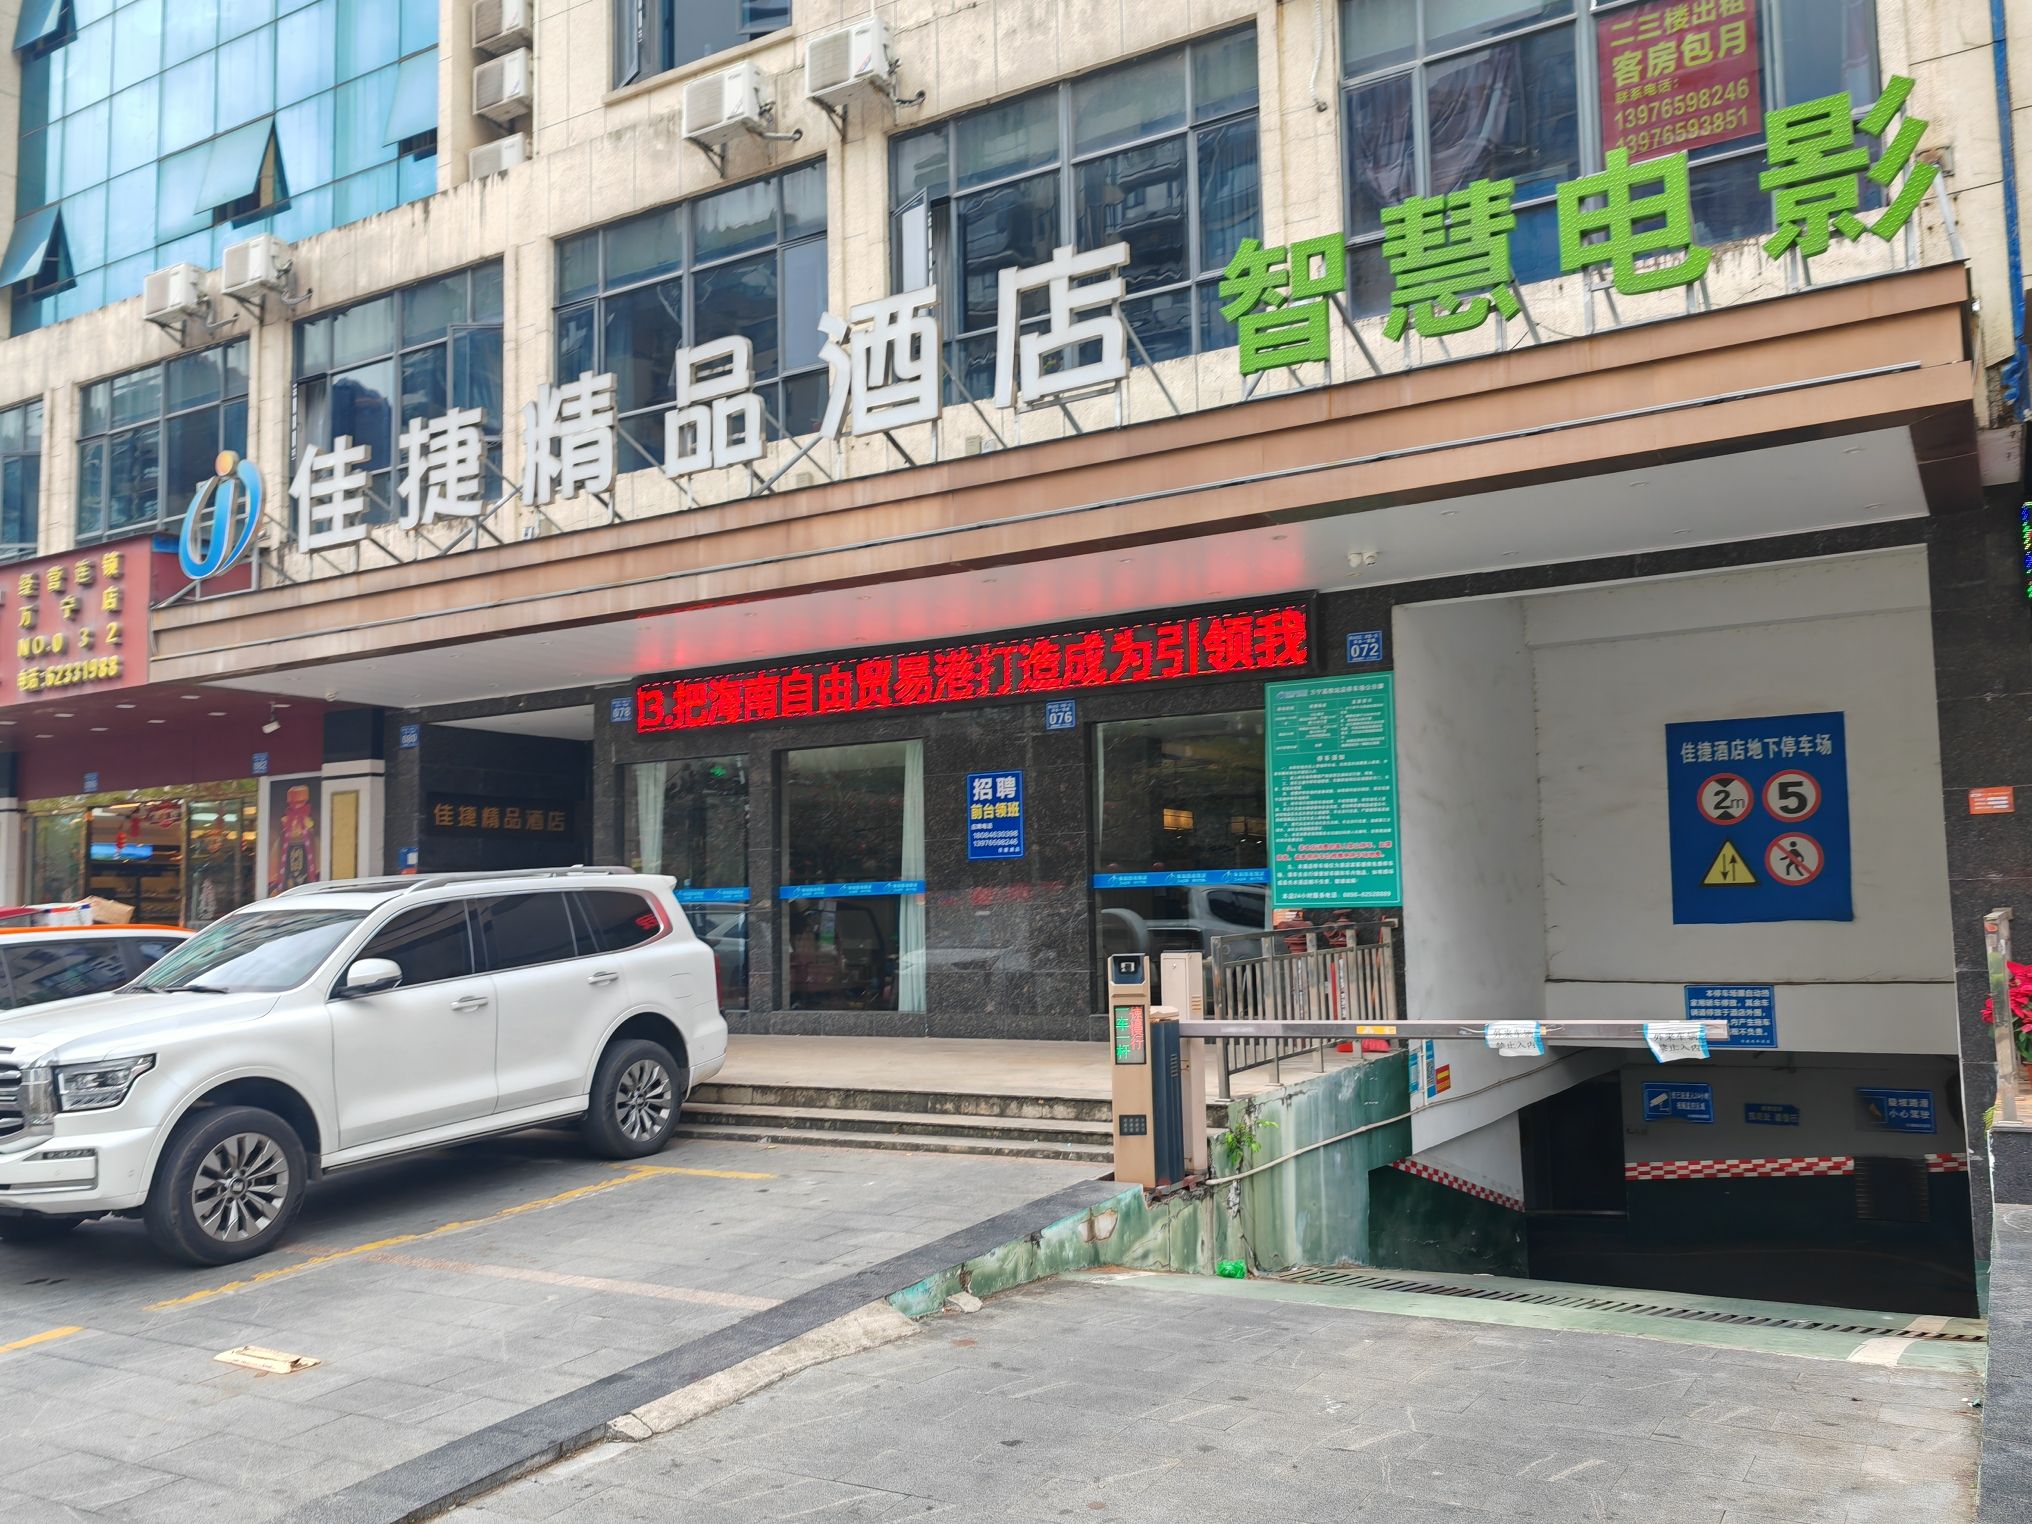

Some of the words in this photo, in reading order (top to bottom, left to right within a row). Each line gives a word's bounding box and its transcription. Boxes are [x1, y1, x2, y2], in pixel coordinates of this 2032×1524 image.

[1612, 20, 1747, 88] 客房包月
[1615, 77, 1750, 130] 13976598246
[289, 241, 1131, 553] 佳捷精品酒店
[1218, 74, 1938, 376] 智慧电影
[1350, 643, 1379, 657] 072
[1050, 712, 1073, 724] 076
[1680, 733, 1833, 763] 佳捷酒店地下停车场
[973, 776, 1017, 801] 招聘
[1778, 780, 1808, 815] 5
[433, 803, 566, 831] 佳捷精品酒店
[971, 801, 1020, 820] 前台领班
[1496, 1041, 1536, 1049] 禁止入内
